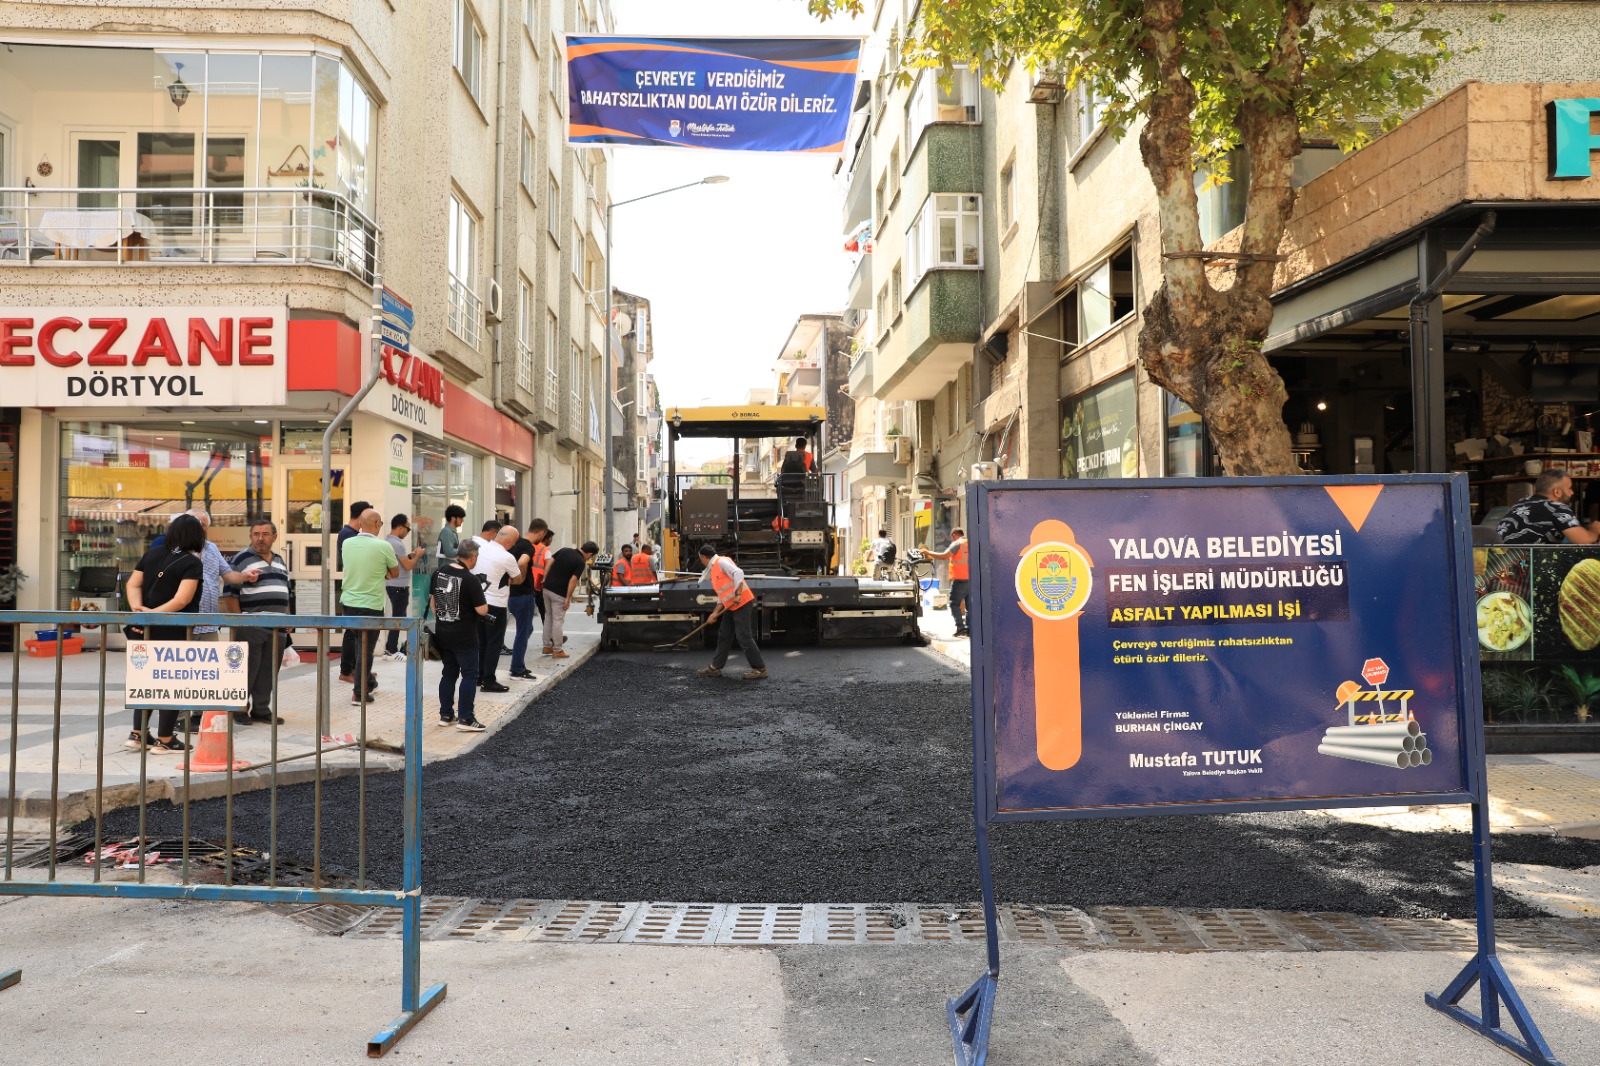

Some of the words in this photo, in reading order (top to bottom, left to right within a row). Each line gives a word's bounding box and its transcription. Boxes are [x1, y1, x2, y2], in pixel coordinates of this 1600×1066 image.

[635, 71, 696, 89] ÇEVREYE
[707, 68, 785, 89] VERDİĞİMİZ
[580, 90, 686, 109] RAHATSIZLIKTAN
[688, 94, 738, 110] DOLAYI
[740, 92, 777, 112] ÖZÜR
[780, 93, 837, 113] DİLERİZ.
[0, 316, 274, 368] ECZANE
[67, 370, 203, 397] DÖRTYOL
[391, 392, 427, 425] DÖRTYOL
[1109, 537, 1200, 560] YALOVA
[1207, 529, 1342, 559] BELEDİYESİ
[1109, 574, 1147, 592] FEN
[1153, 568, 1214, 595] İŞLERİ
[1220, 565, 1344, 589] MÜDÜRLÜĞÜ
[1111, 607, 1175, 622] ASFALT
[1180, 603, 1273, 620] YAPILMASI
[1278, 600, 1301, 620] İŞİ
[1113, 639, 1157, 651] Çevreye
[1160, 638, 1215, 649] verdiğimiz
[1218, 636, 1293, 647] rahatsızlıktan
[153, 647, 219, 663] YALOVA
[1113, 654, 1143, 664] ötürü
[1146, 653, 1170, 663] özür
[1173, 652, 1208, 662] dileriz.
[152, 667, 219, 680] BELEDİYESİ
[129, 688, 171, 699] ZABITA
[173, 687, 247, 700] MÜDÜRLÜĞÜ
[1115, 711, 1158, 719] Yüklenici
[1160, 710, 1190, 718] Firma:
[1115, 723, 1161, 733] BURHAN
[1163, 721, 1204, 733] ÇİNGAY
[1129, 752, 1197, 768] Mustafa
[1202, 749, 1262, 766] TUTUK
